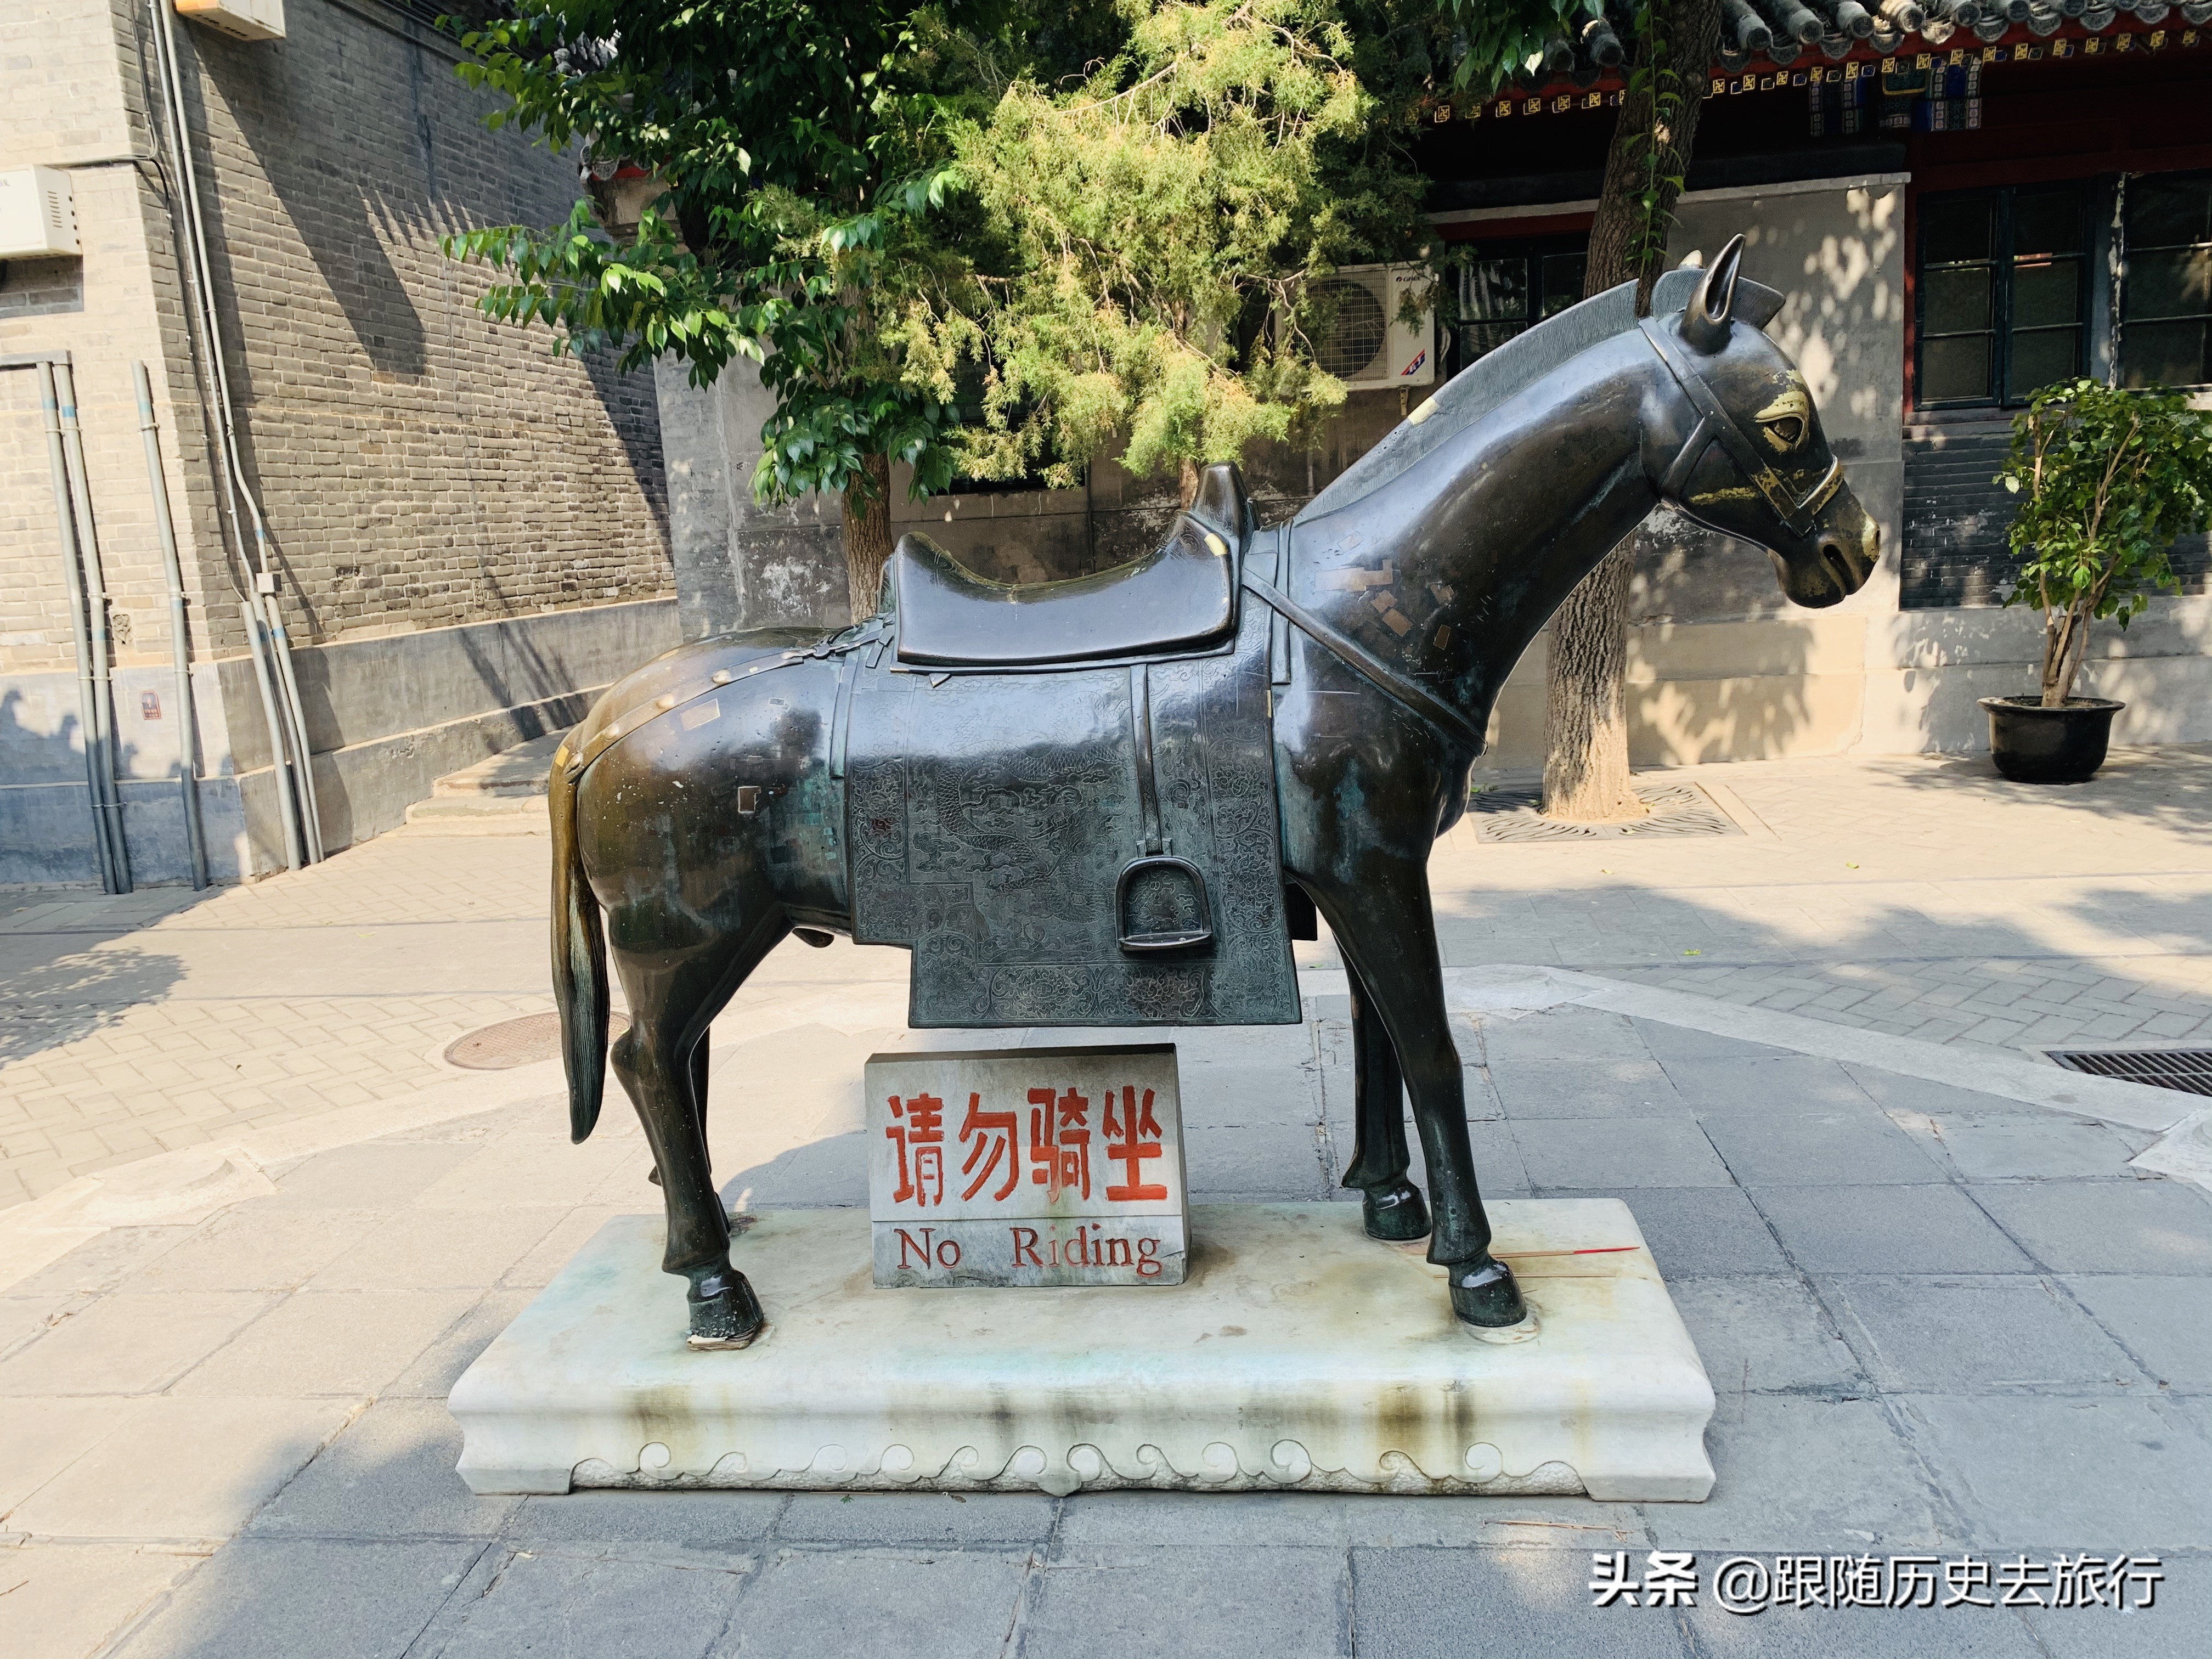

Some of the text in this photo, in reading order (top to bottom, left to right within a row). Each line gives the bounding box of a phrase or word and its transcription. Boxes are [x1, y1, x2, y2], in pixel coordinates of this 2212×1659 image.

[885, 1085, 1167, 1207] 请勿骑坐
[893, 1222, 1163, 1278] No Riding
